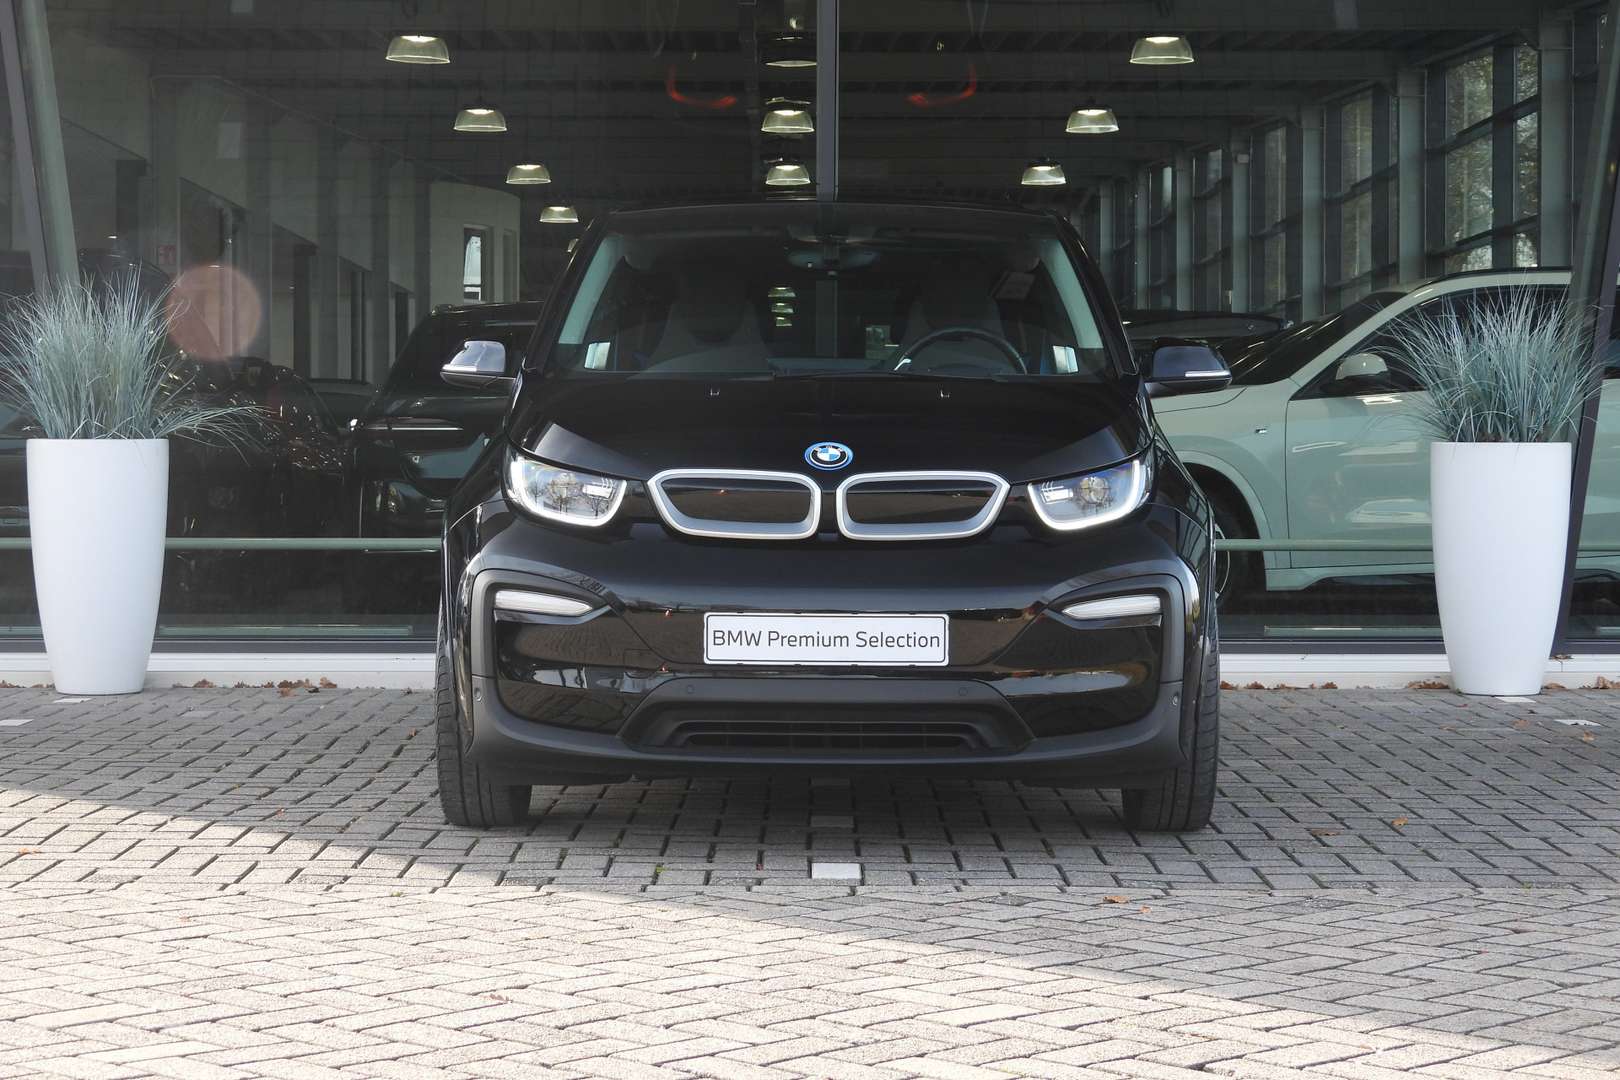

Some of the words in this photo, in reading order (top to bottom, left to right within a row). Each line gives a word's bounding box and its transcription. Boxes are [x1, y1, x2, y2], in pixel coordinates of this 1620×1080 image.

[712, 629, 763, 647] BMW
[767, 630, 850, 648] Premium
[855, 631, 941, 648] Selection
